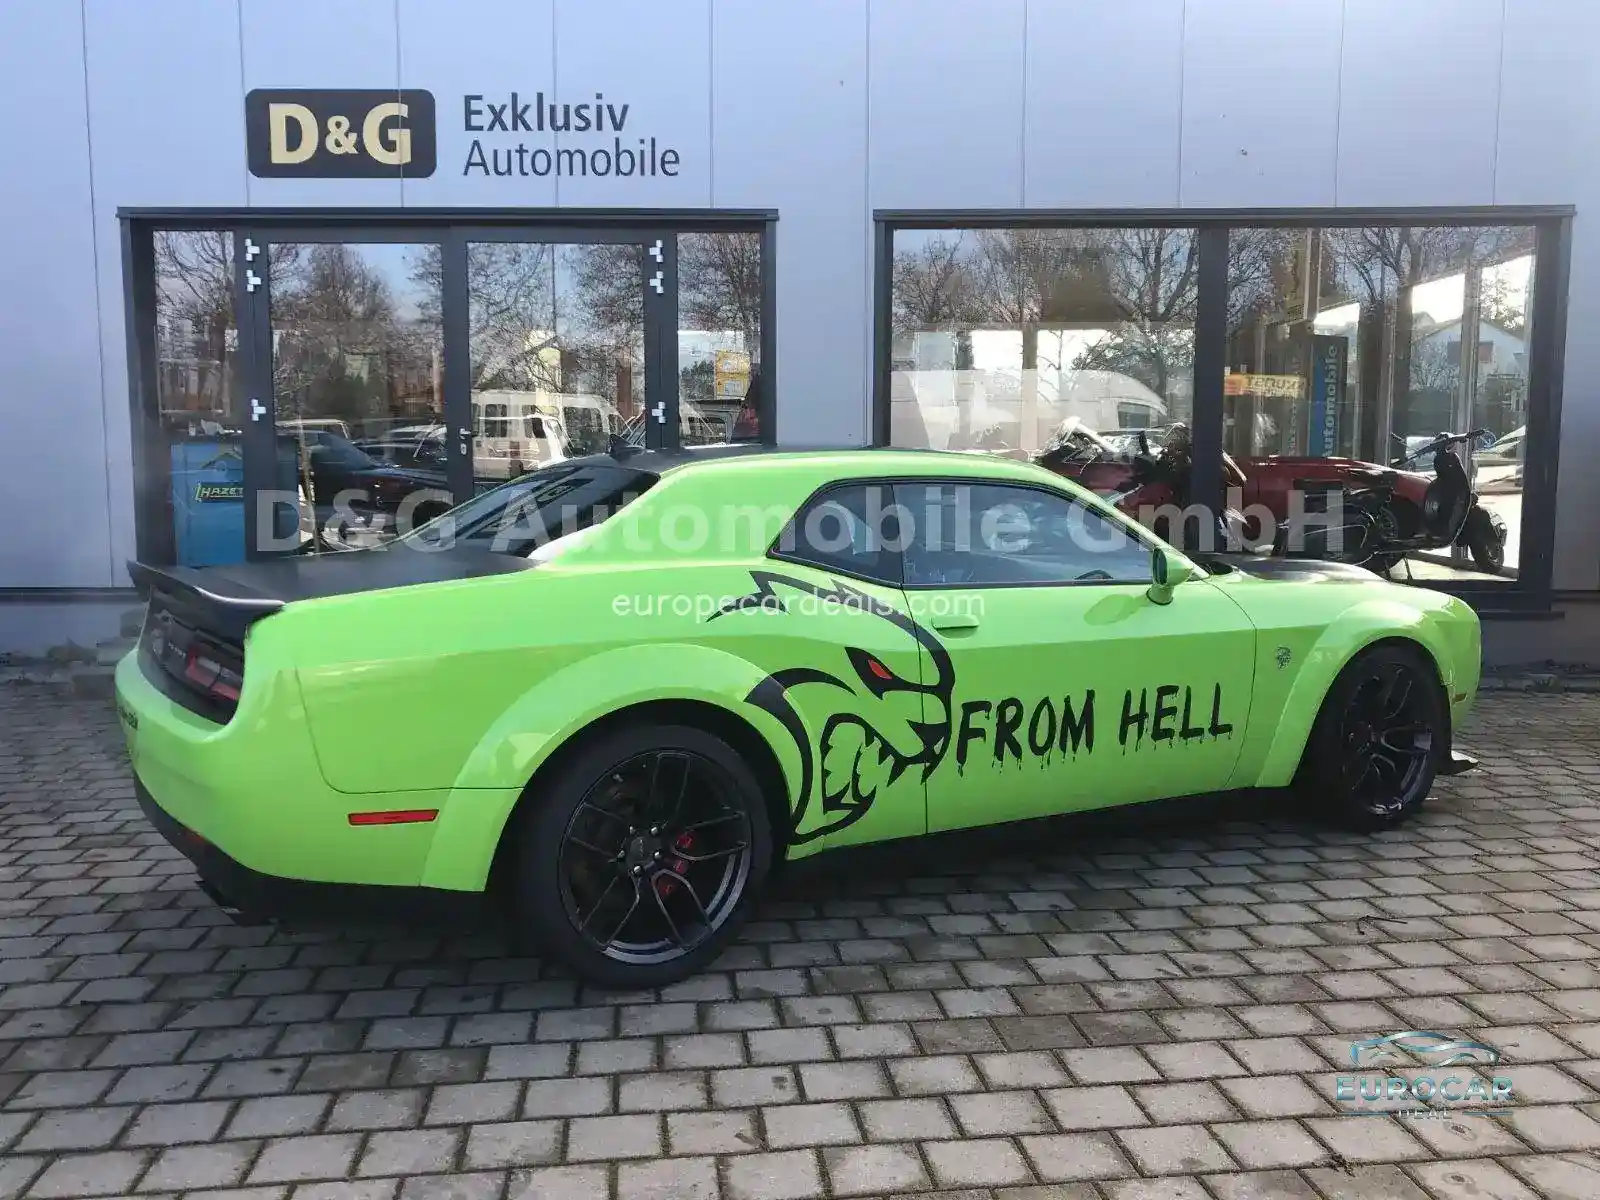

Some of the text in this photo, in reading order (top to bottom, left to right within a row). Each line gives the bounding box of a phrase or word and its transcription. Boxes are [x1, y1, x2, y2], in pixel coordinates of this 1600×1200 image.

[268, 102, 412, 165] D&G
[463, 92, 630, 132] Exklusiv
[463, 137, 680, 177] Automobile
[956, 682, 1233, 772] FROM HELL
